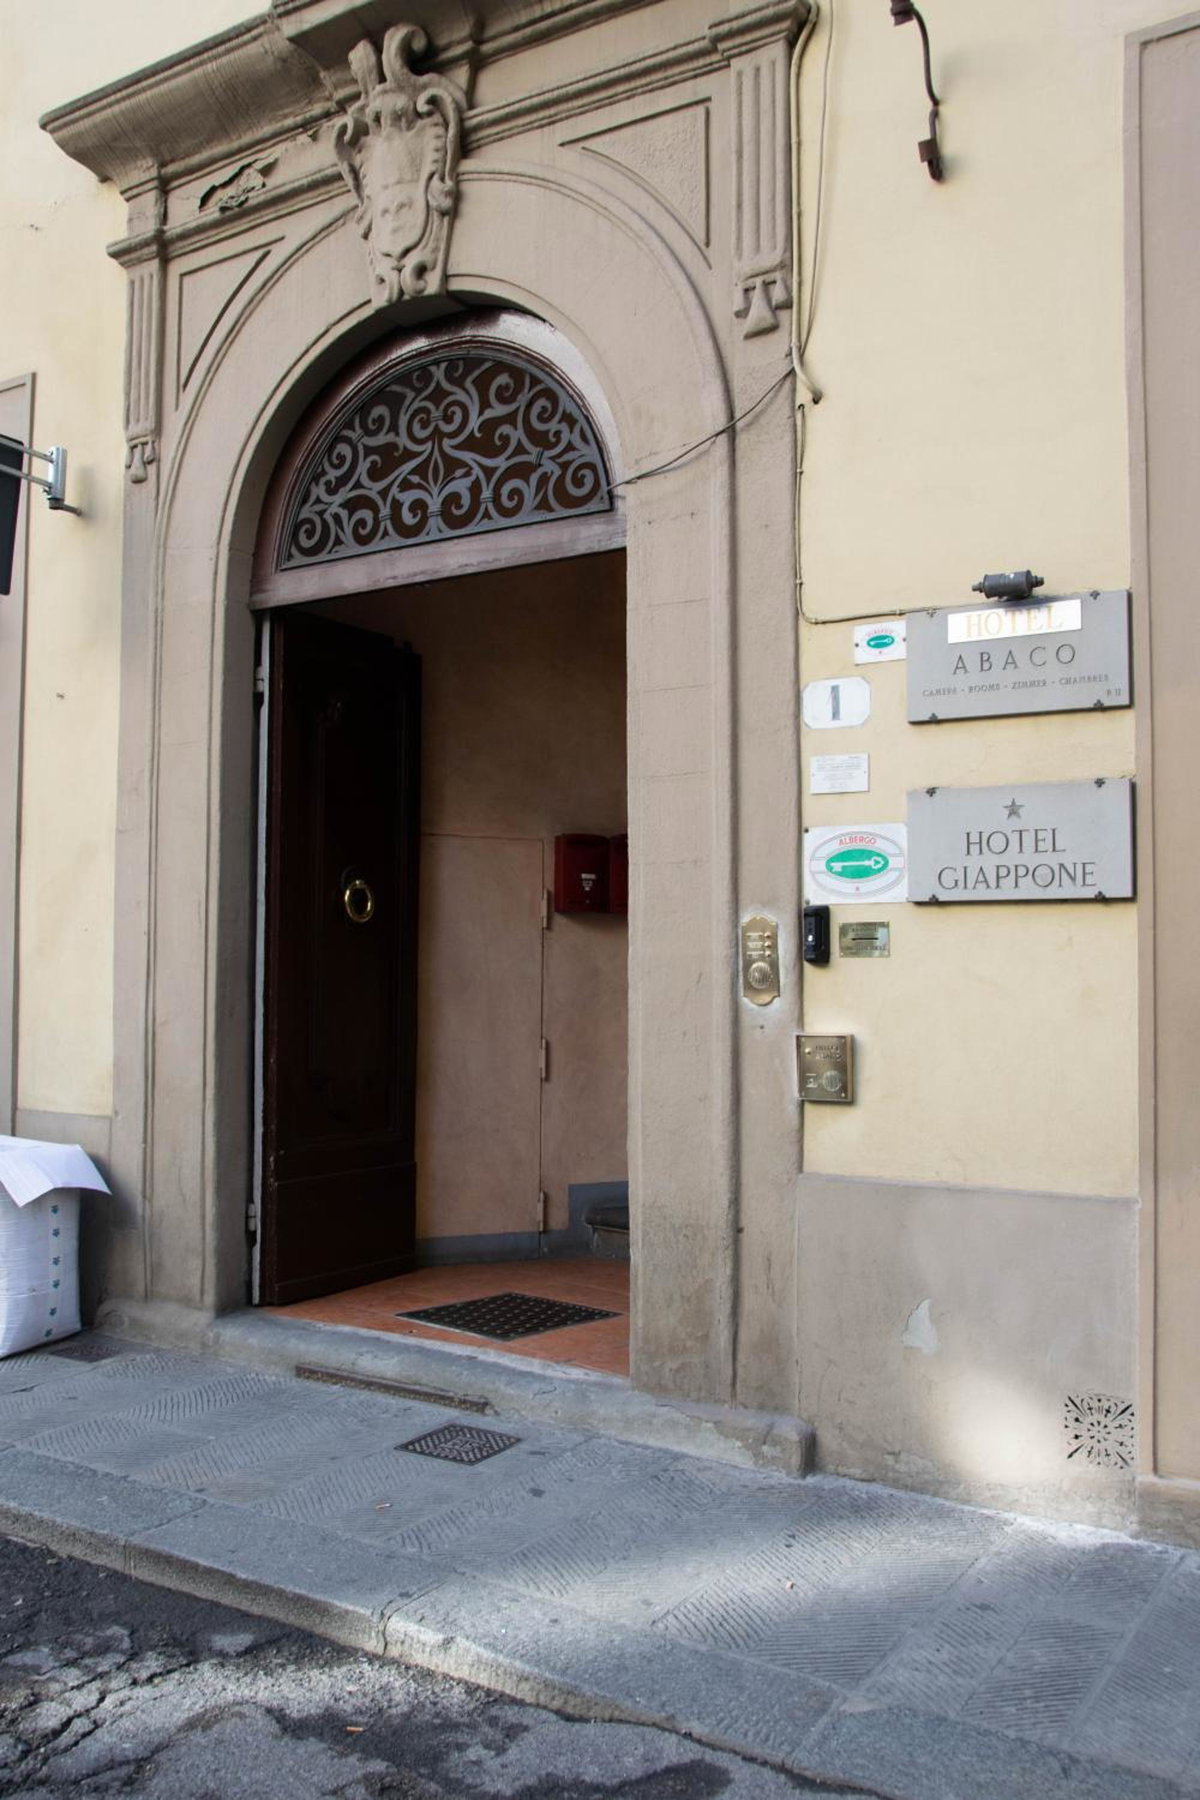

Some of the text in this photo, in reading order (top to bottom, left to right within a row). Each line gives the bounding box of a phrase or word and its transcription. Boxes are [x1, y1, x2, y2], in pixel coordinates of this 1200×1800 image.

[966, 605, 1064, 638] HOTEL
[953, 643, 1076, 675] ABACO
[838, 835, 877, 846] ALBERGO
[965, 828, 1067, 857] HOTEL
[937, 862, 1097, 890] GIAPPONE
